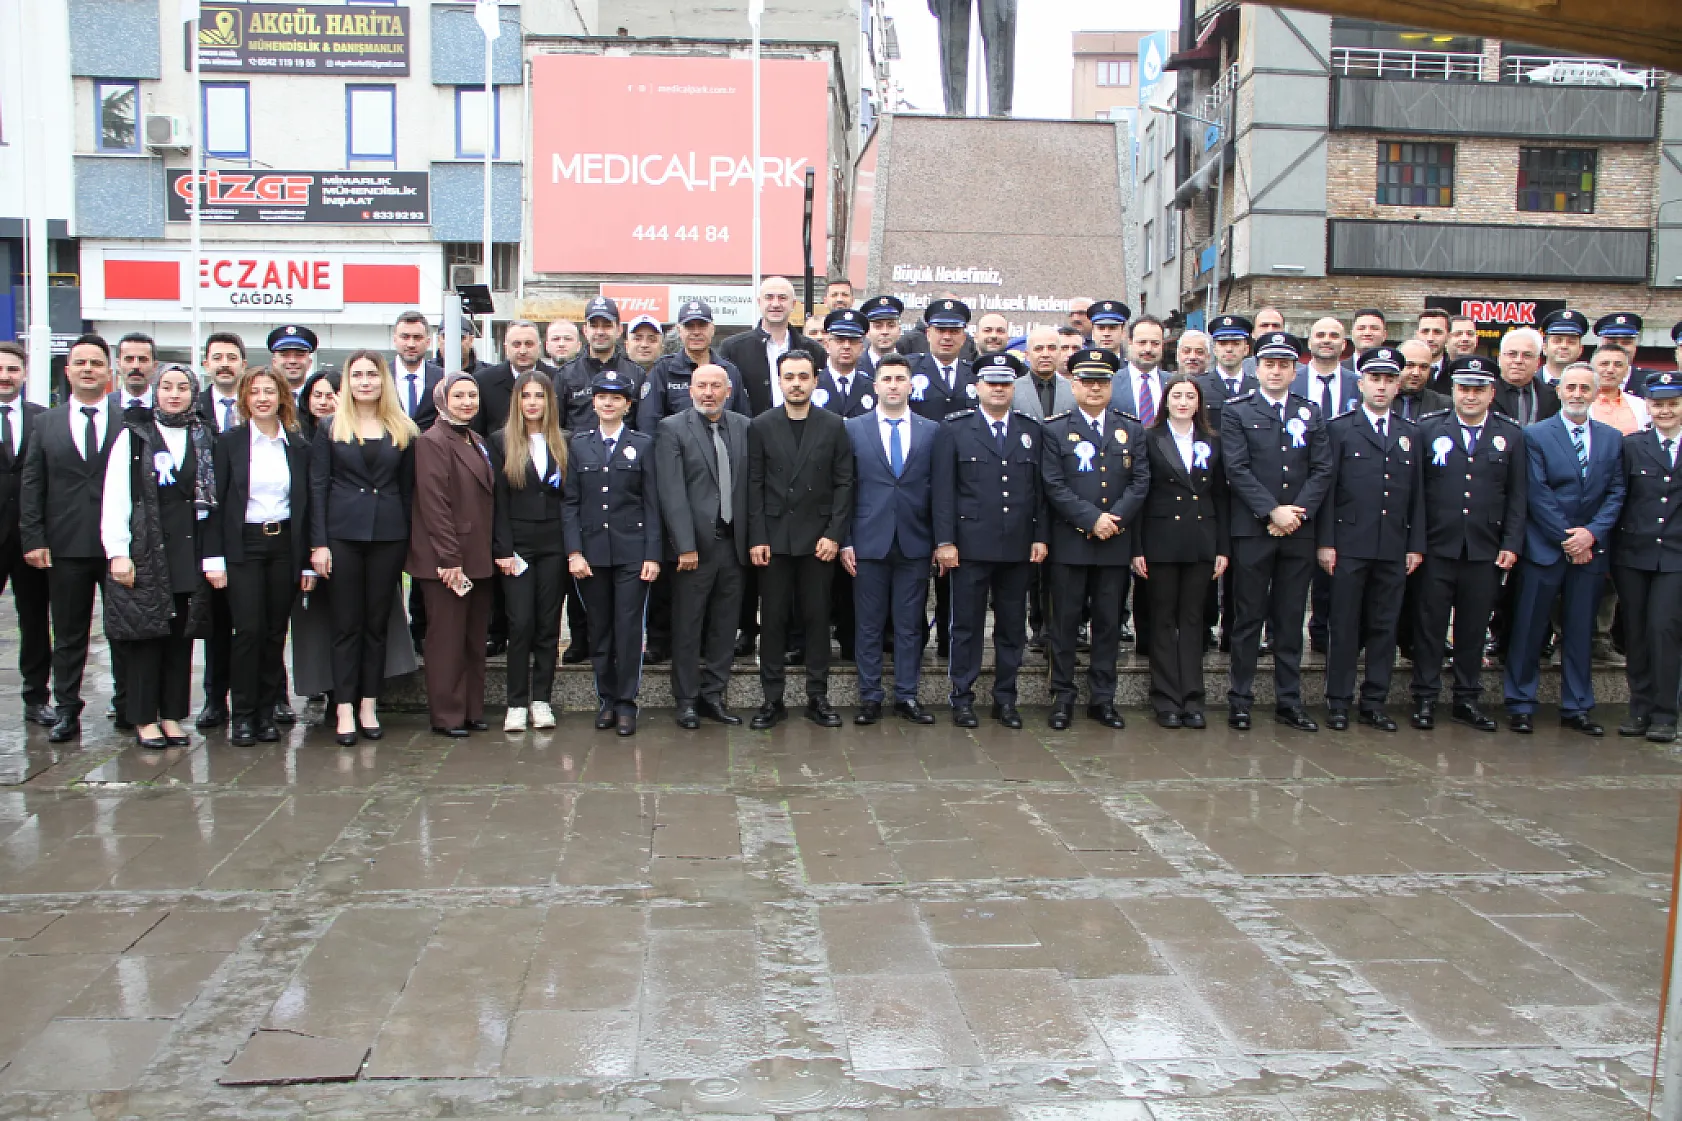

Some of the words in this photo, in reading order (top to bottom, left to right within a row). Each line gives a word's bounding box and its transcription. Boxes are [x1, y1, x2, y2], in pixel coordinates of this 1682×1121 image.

[248, 8, 321, 35] AKGÜL
[325, 10, 405, 36] HARİTA
[248, 39, 320, 53] MÜHENDİSLİK
[322, 42, 331, 53] &
[333, 42, 404, 56] DANIŞMANLIK
[257, 57, 277, 66] 0542
[321, 175, 391, 185] MİMARLIK
[321, 186, 417, 195] MÜHENDİSLİK
[321, 196, 374, 208] İNŞAAT
[373, 211, 394, 219] 833
[632, 225, 669, 241] 444
[674, 225, 699, 241] 44
[705, 225, 730, 242] 84
[199, 259, 331, 289] ECZANE
[230, 291, 293, 309] ÇAĞDAŞ
[1461, 301, 1537, 324] IRMAK
